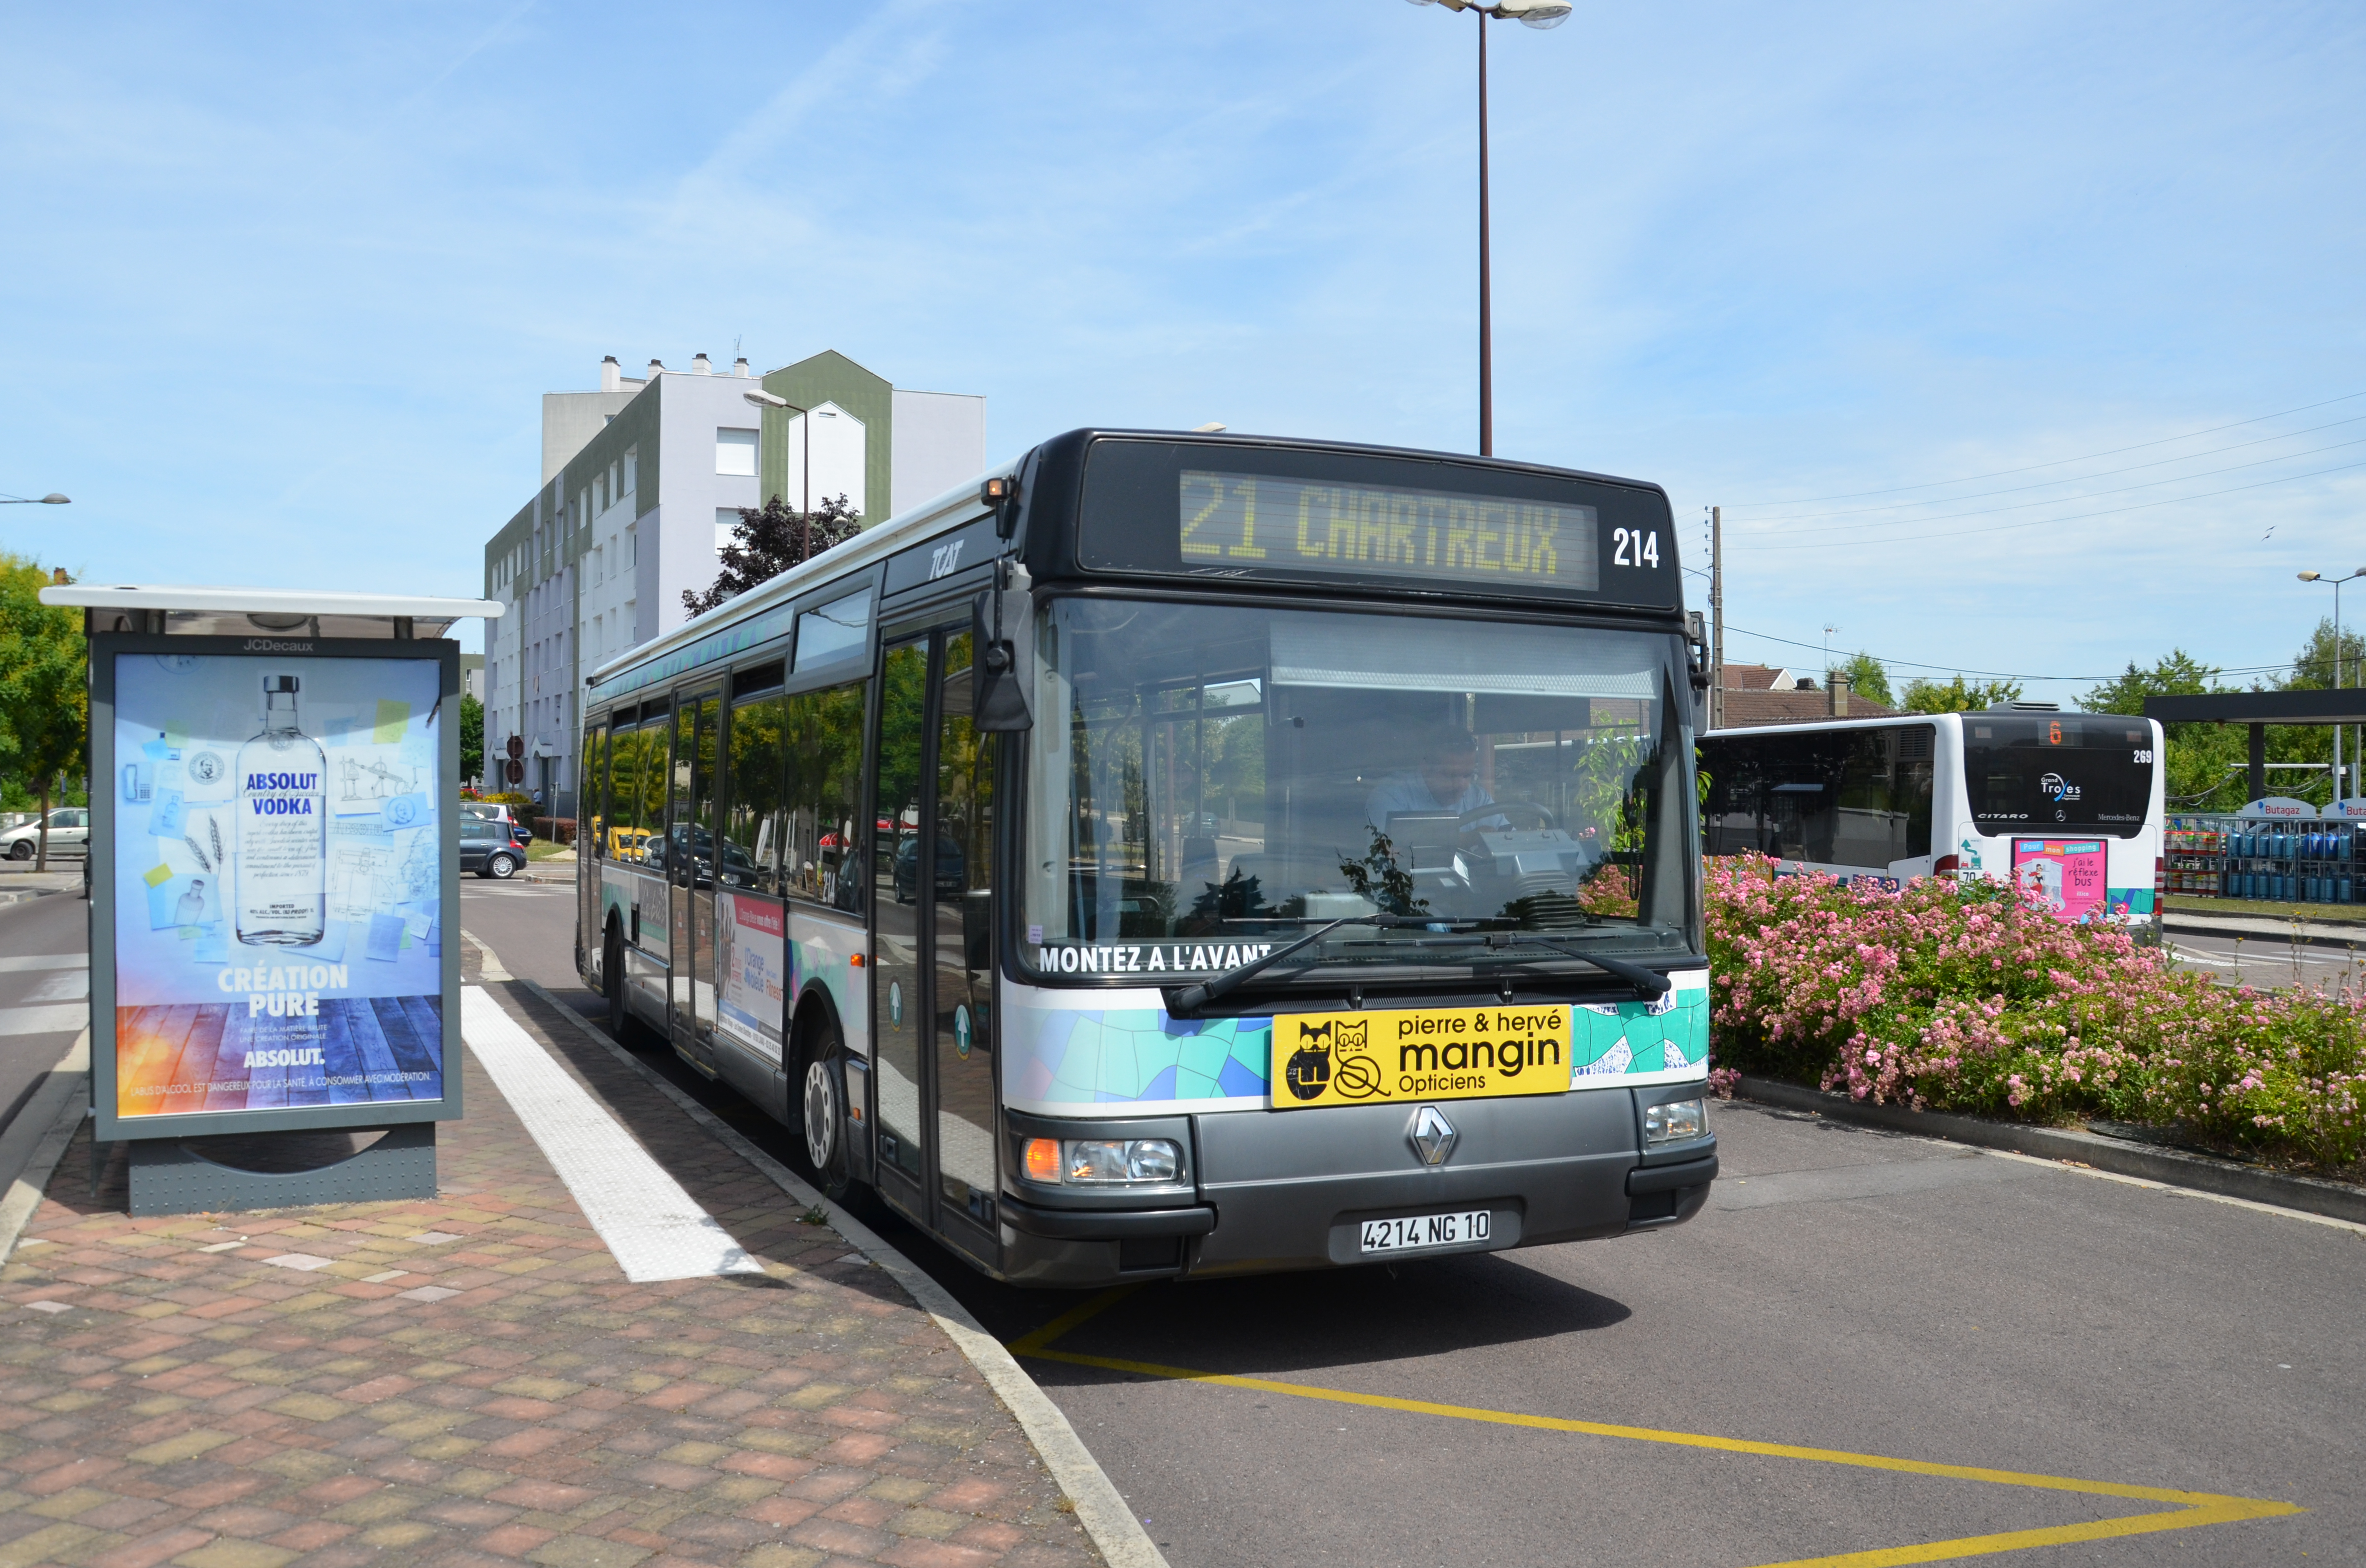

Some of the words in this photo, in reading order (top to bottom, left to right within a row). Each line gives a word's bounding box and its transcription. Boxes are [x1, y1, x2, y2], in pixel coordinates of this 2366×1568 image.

[1179, 472, 1266, 558] 21
[1297, 485, 1559, 575] CHARTREUX
[1613, 527, 1659, 568] 214
[929, 538, 965, 581] TCAT
[244, 639, 313, 651] JCDecaux
[2050, 720, 2062, 744] 6
[2133, 749, 2152, 764] 269
[246, 773, 317, 790] ABSOLUT
[252, 798, 312, 815] VODKA
[2098, 813, 2140, 822] Mercedes-Benz
[2265, 805, 2300, 816] Butagaz
[2066, 844, 2097, 852] shopping
[2068, 868, 2099, 876] réflexe
[2072, 858, 2085, 868] j'ai
[2087, 858, 2093, 866] le
[823, 870, 835, 904] 214
[2074, 876, 2092, 887] bus
[1040, 947, 1140, 973] MONTEZ
[1147, 946, 1166, 971] A
[218, 959, 348, 992] CRÉATION
[249, 991, 319, 1018] PURE
[280, 1024, 306, 1032] MATIÈRE
[1399, 1015, 1466, 1040] pierre
[1474, 1013, 1490, 1032] &
[1498, 1008, 1562, 1031] hervé
[255, 1033, 289, 1042] CRÉATION
[291, 1033, 327, 1041] ORIGINALE.
[243, 1048, 326, 1069] ABSOLUT.
[1399, 1032, 1560, 1077] mangin
[130, 1086, 154, 1097] L'ABUS
[156, 1084, 193, 1095] D'ALCOOL
[194, 1083, 206, 1093] EST
[207, 1081, 250, 1093] DANGEREUX
[252, 1080, 272, 1089] POUR
[273, 1079, 282, 1088] LA
[283, 1077, 307, 1088] SANTÉ,
[309, 1075, 315, 1086] À
[316, 1075, 363, 1086] CONSOMMER
[365, 1073, 382, 1083] AVEC
[383, 1071, 431, 1082] MODÉRATION.
[1399, 1073, 1485, 1096] Opticiens
[1363, 1219, 1420, 1249] 4214
[1428, 1215, 1456, 1243] NG
[1465, 1212, 1489, 1239] 10
